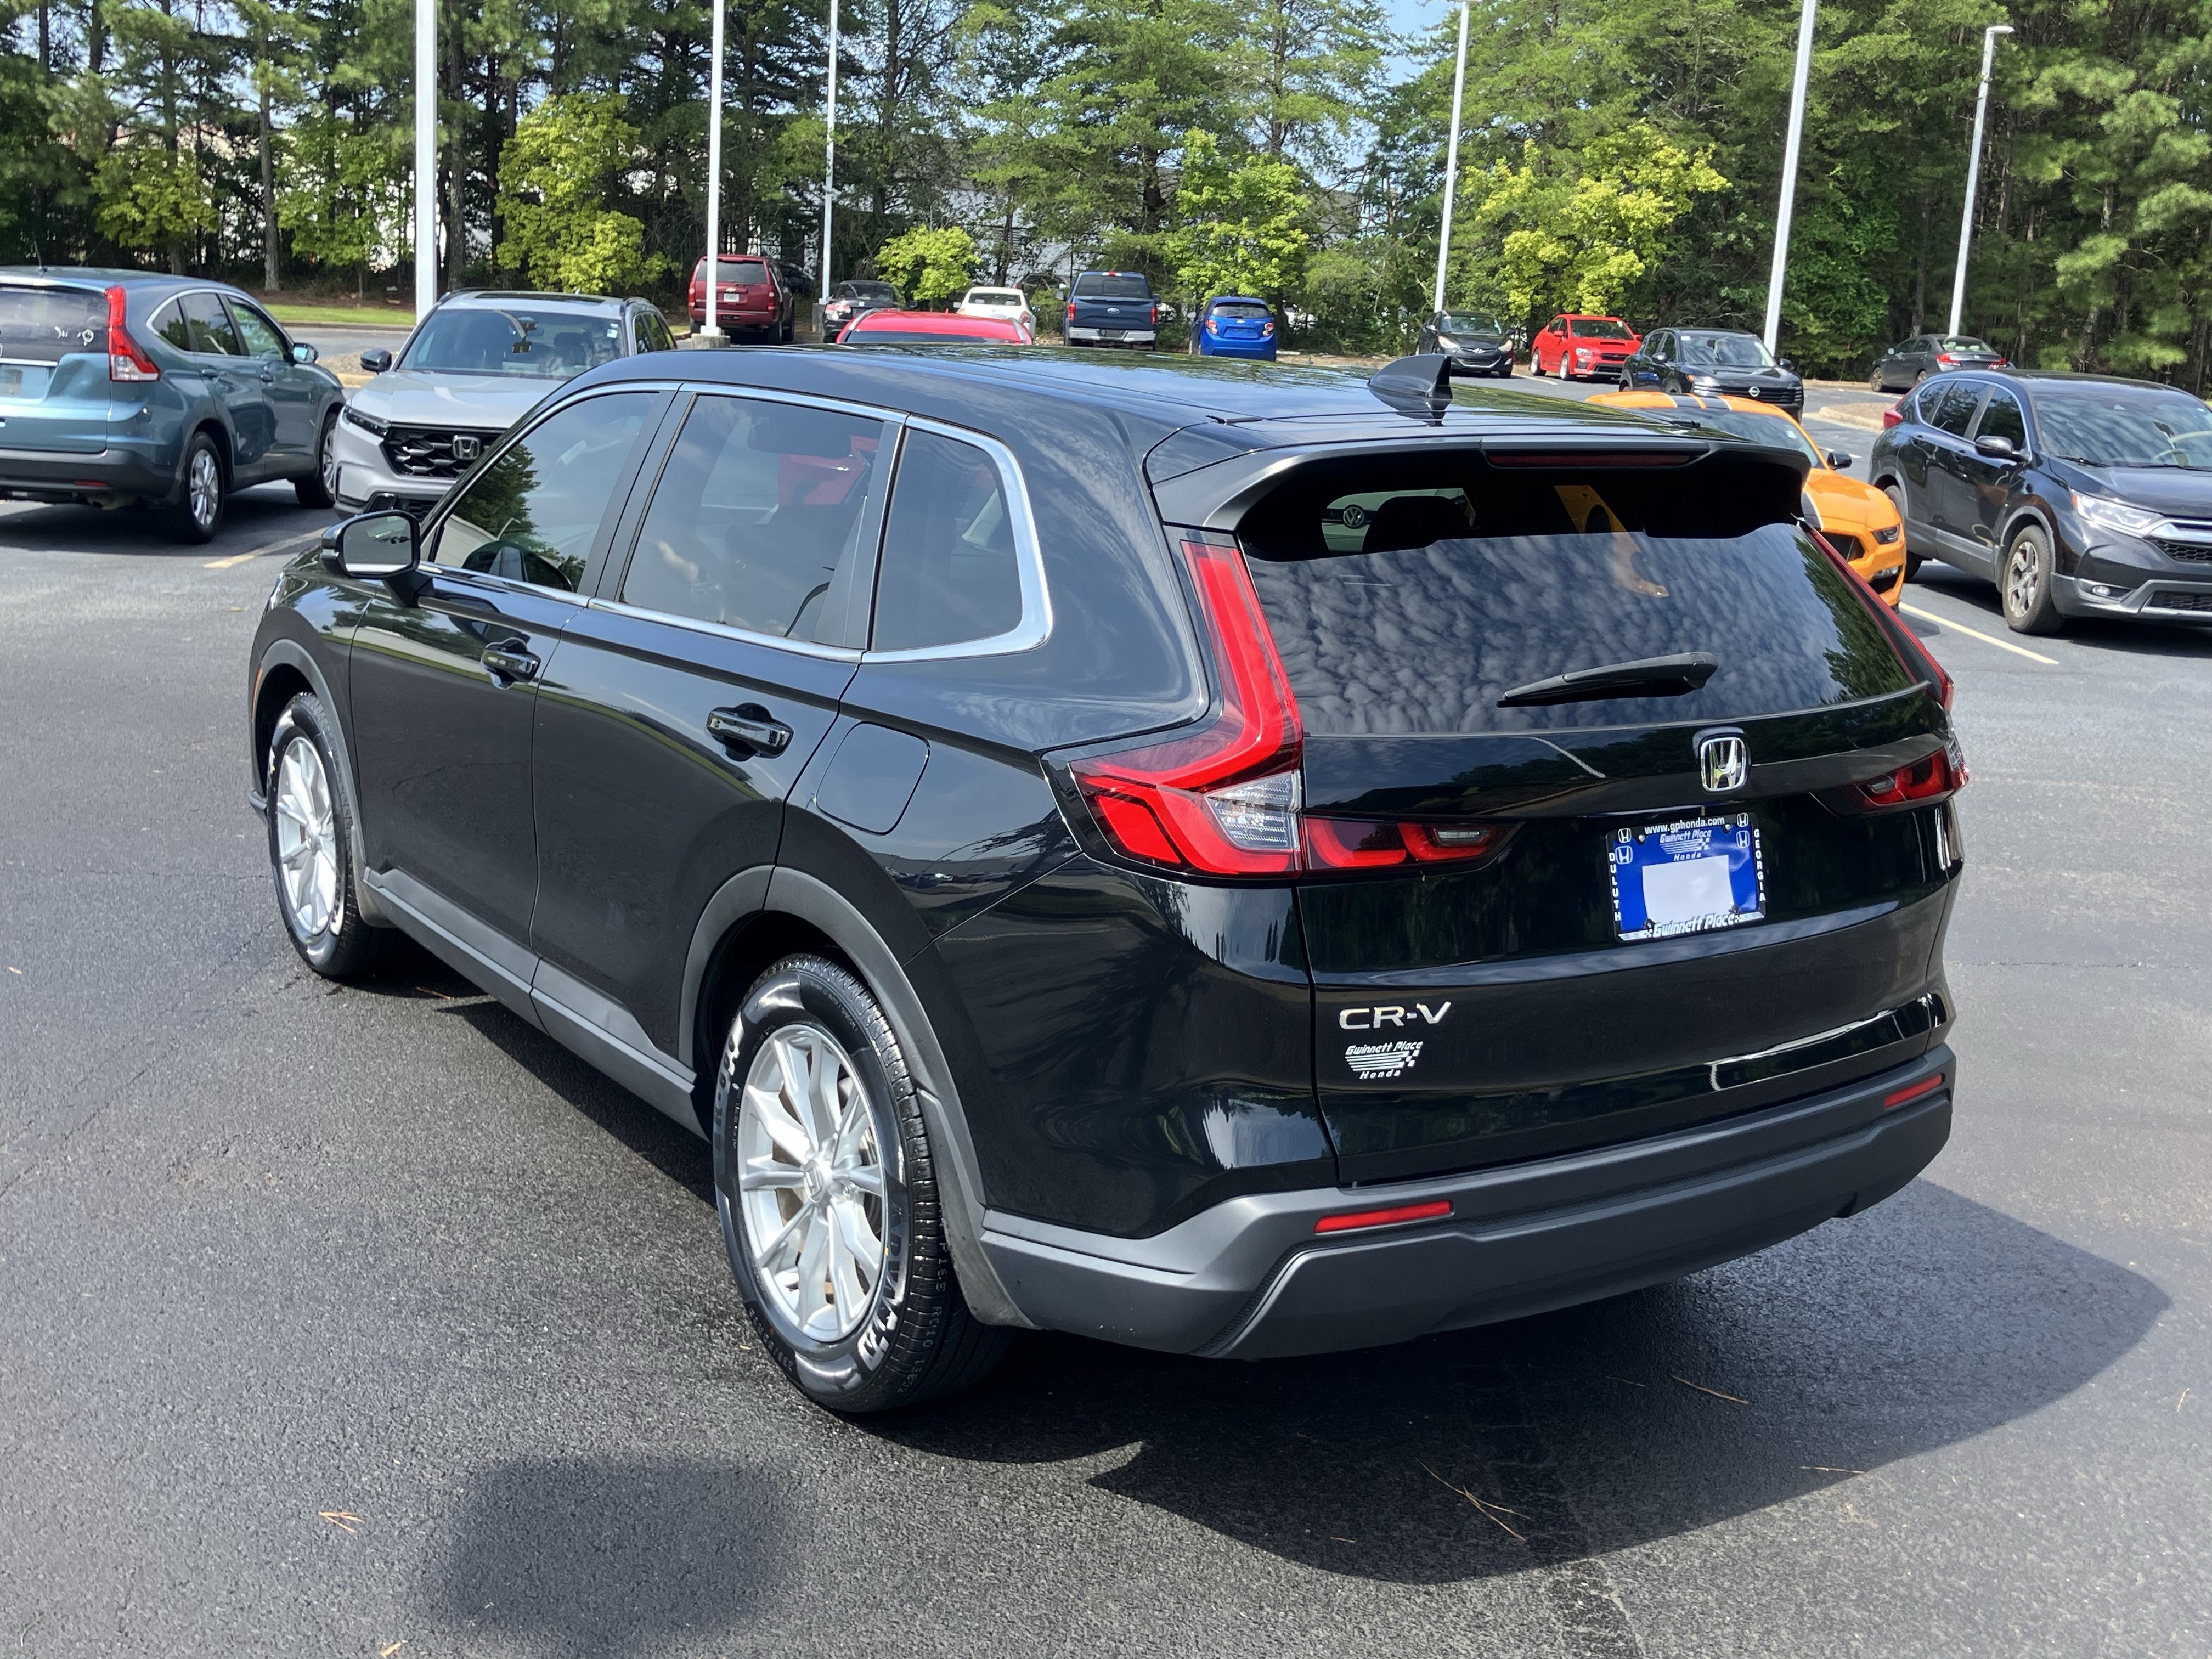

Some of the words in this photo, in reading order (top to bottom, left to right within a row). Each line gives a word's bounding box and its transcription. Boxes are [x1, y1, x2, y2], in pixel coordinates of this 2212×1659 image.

[1644, 817, 1725, 834] www.gphonda.com
[1659, 831, 1691, 843] Gwinnett
[1691, 829, 1712, 839] Place
[1673, 851, 1701, 861] Honda
[1754, 829, 1766, 901] GEORGIA
[1609, 852, 1621, 922] DULUTH
[1652, 916, 1703, 938] Gwinnett
[1703, 913, 1735, 929] Place
[1339, 1001, 1451, 1030] CR-V
[1345, 1042, 1393, 1055] Gwinnett
[1393, 1041, 1423, 1052] Place
[1359, 1069, 1401, 1080] Honda
